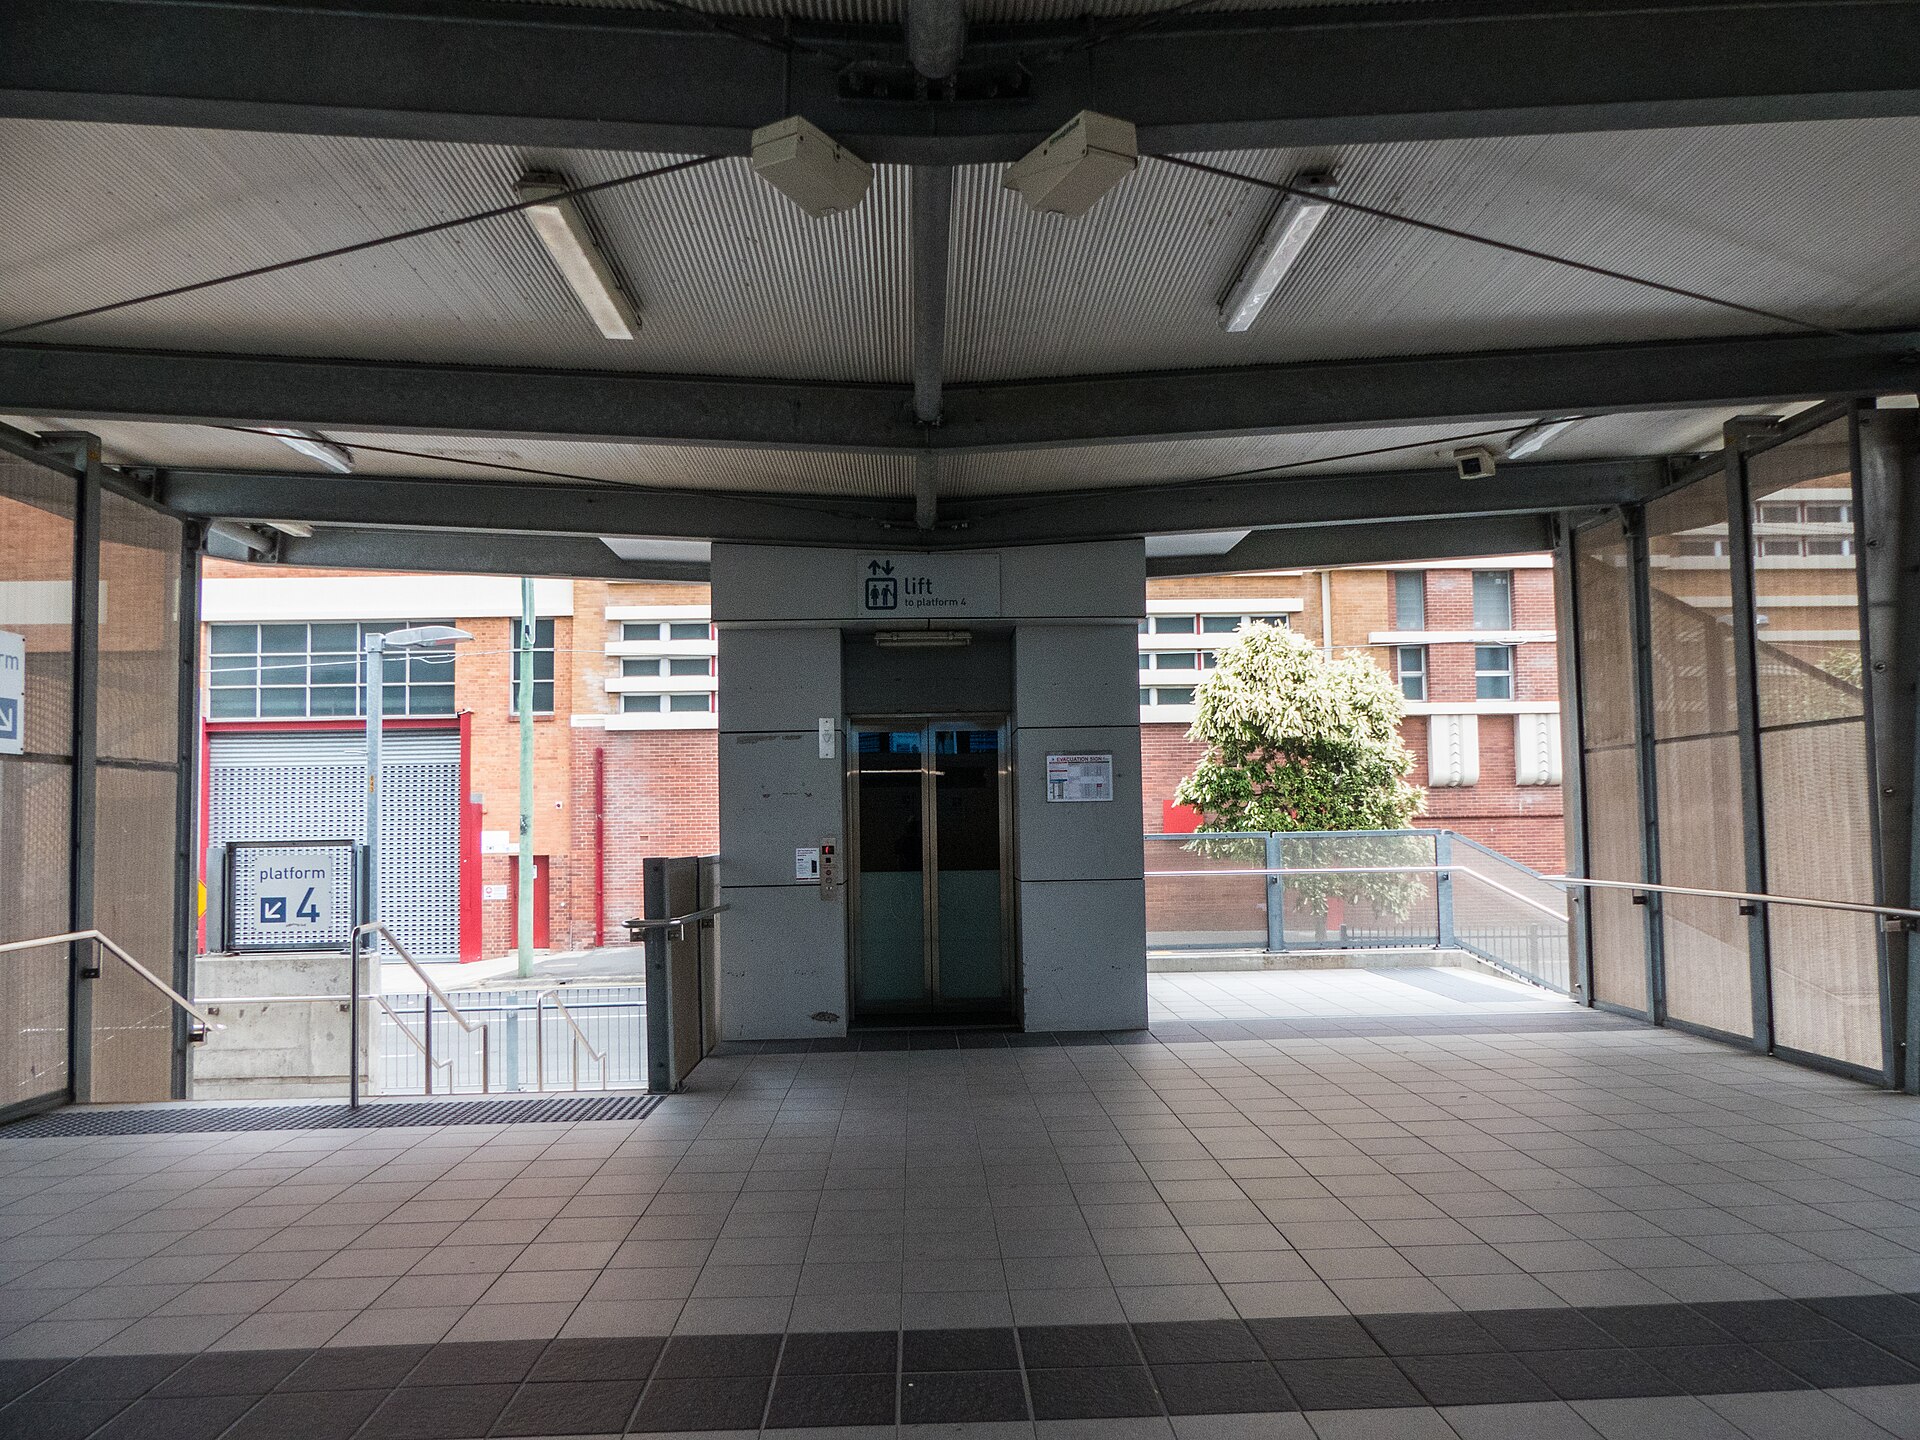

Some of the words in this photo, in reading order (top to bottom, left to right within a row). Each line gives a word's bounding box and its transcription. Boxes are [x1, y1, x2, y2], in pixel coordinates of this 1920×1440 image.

[905, 577, 933, 595] lift
[905, 599, 914, 607] to
[917, 597, 958, 609] platform
[960, 598, 967, 606] 4
[259, 866, 326, 883] platform
[296, 887, 320, 923] 4
